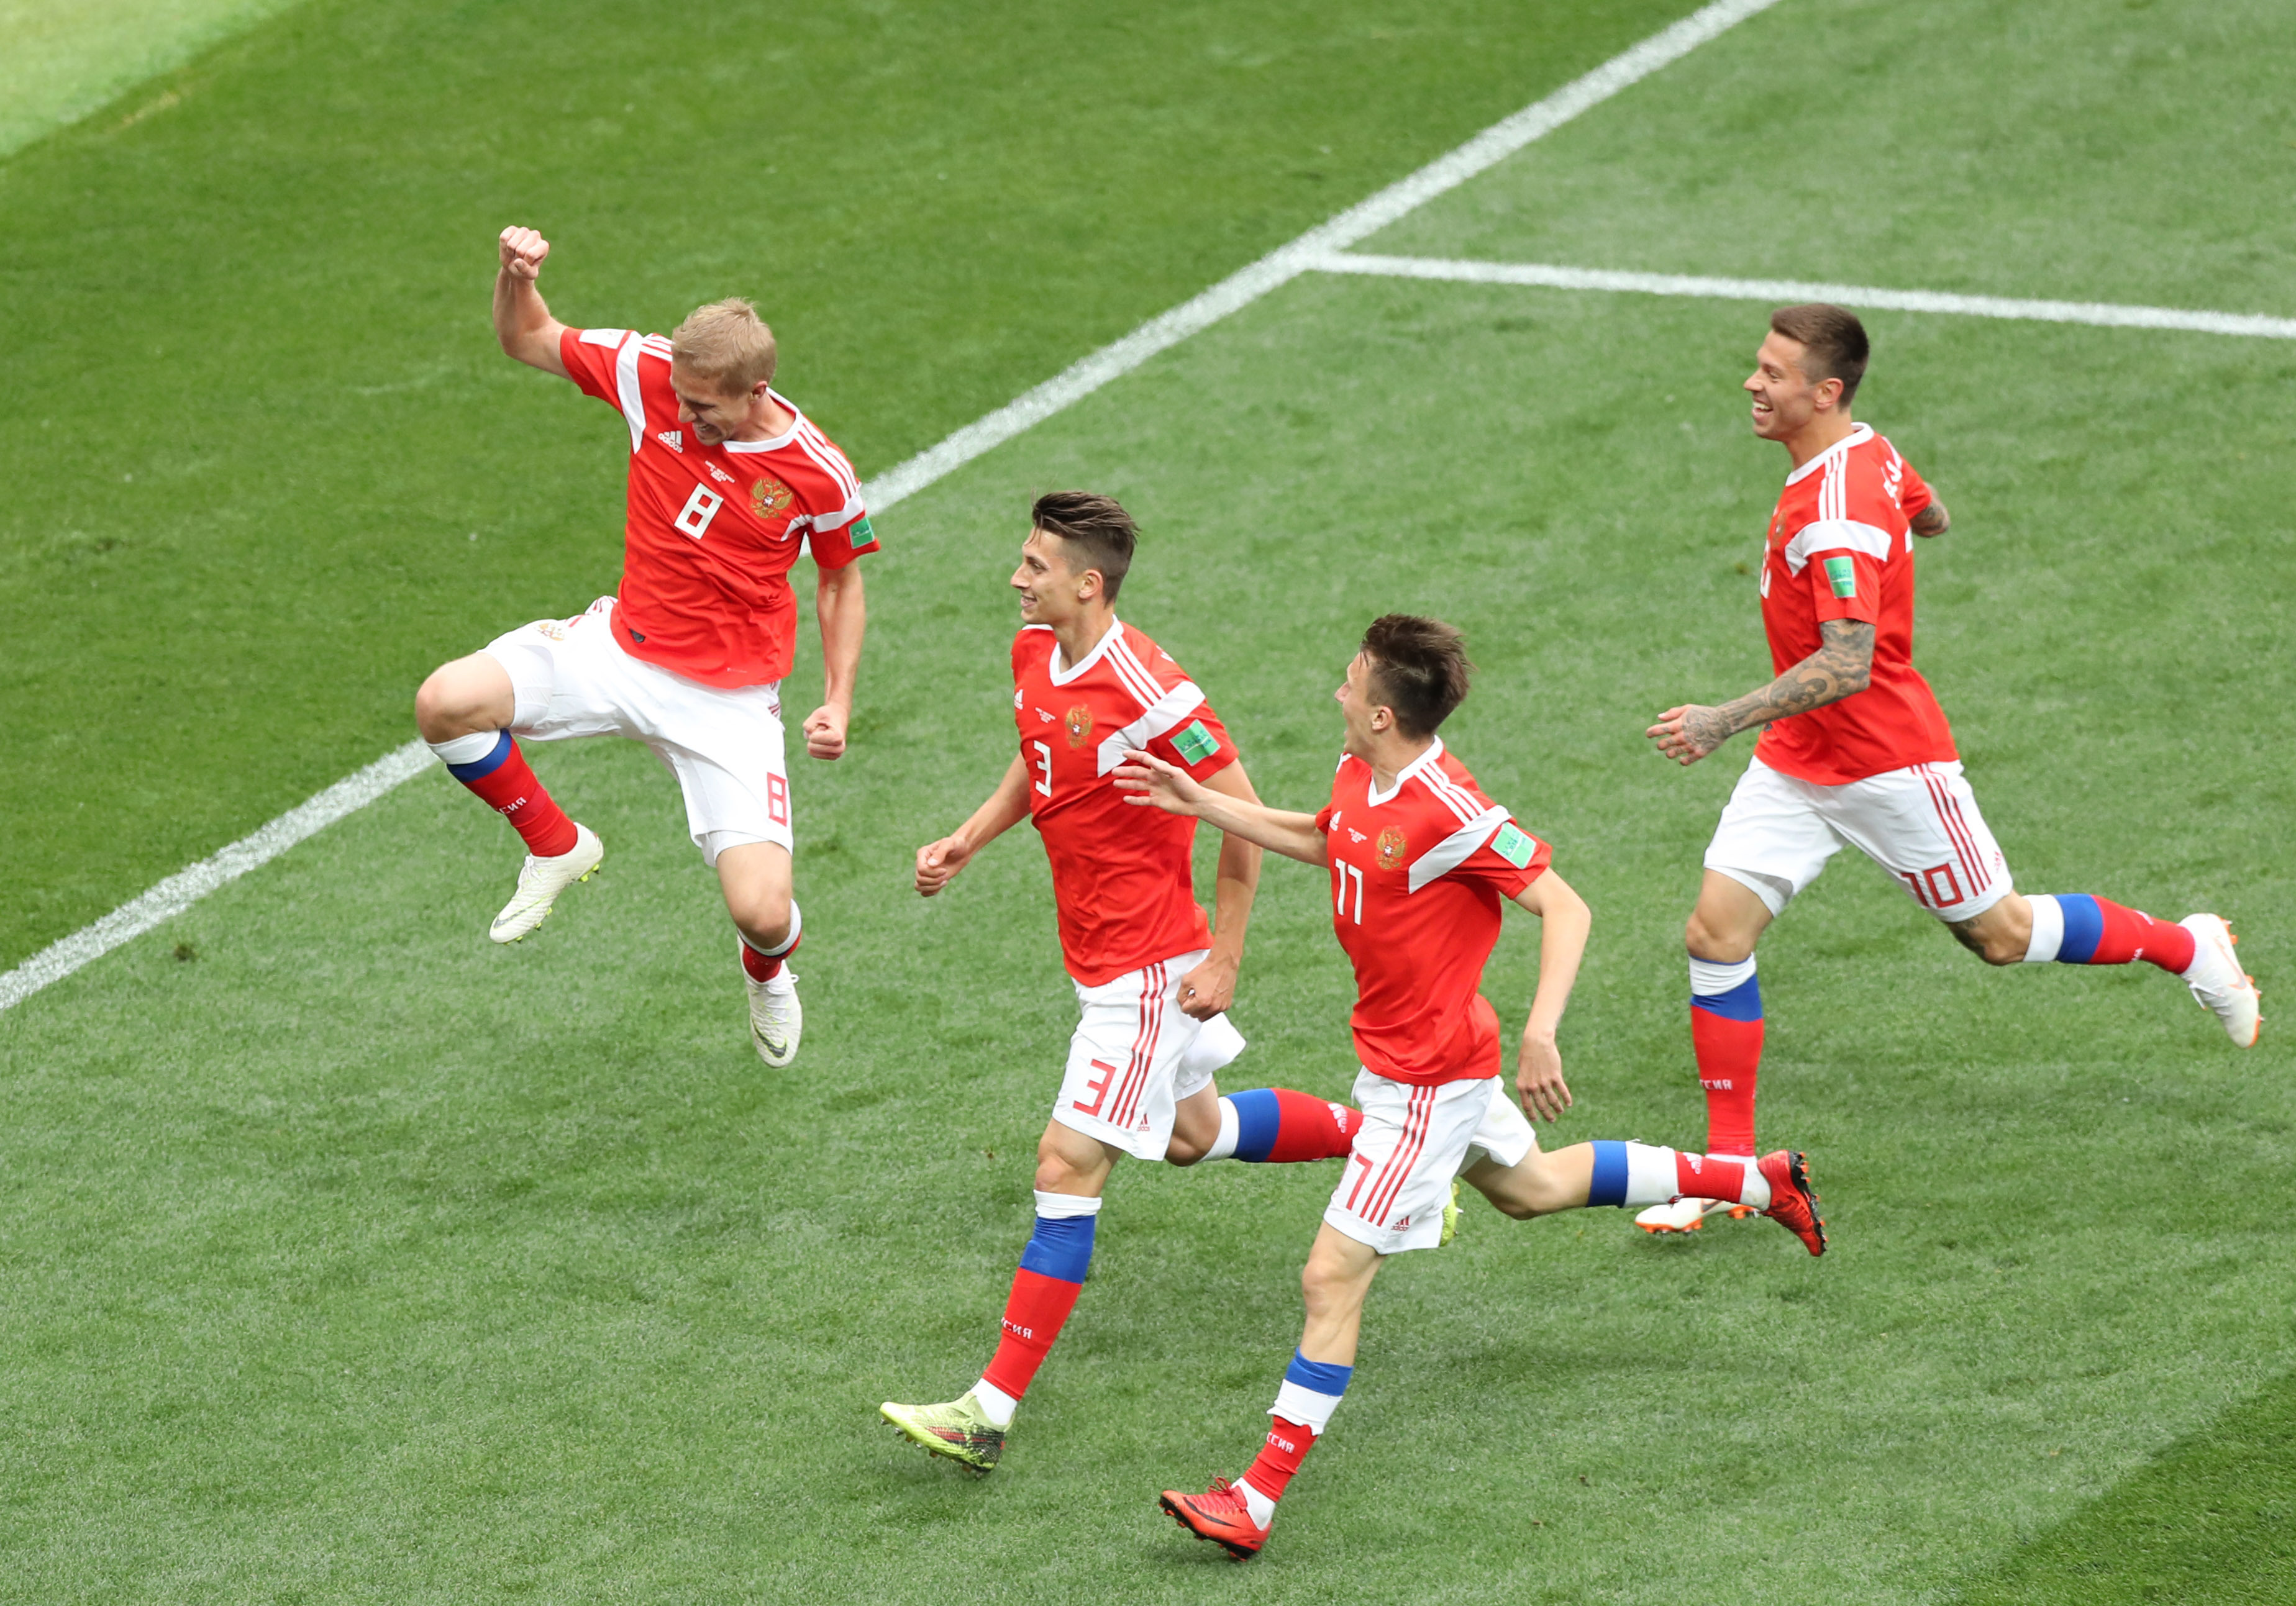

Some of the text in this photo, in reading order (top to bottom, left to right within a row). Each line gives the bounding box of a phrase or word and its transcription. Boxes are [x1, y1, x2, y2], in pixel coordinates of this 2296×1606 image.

[658, 433, 683, 453] adidas
[674, 483, 724, 540] 8
[1034, 740, 1052, 797] 3
[767, 772, 787, 827] 8
[1336, 858, 1363, 925] 17
[1901, 863, 1964, 908] 10
[1073, 1059, 1116, 1117] 3
[1337, 1149, 1374, 1210] 7
